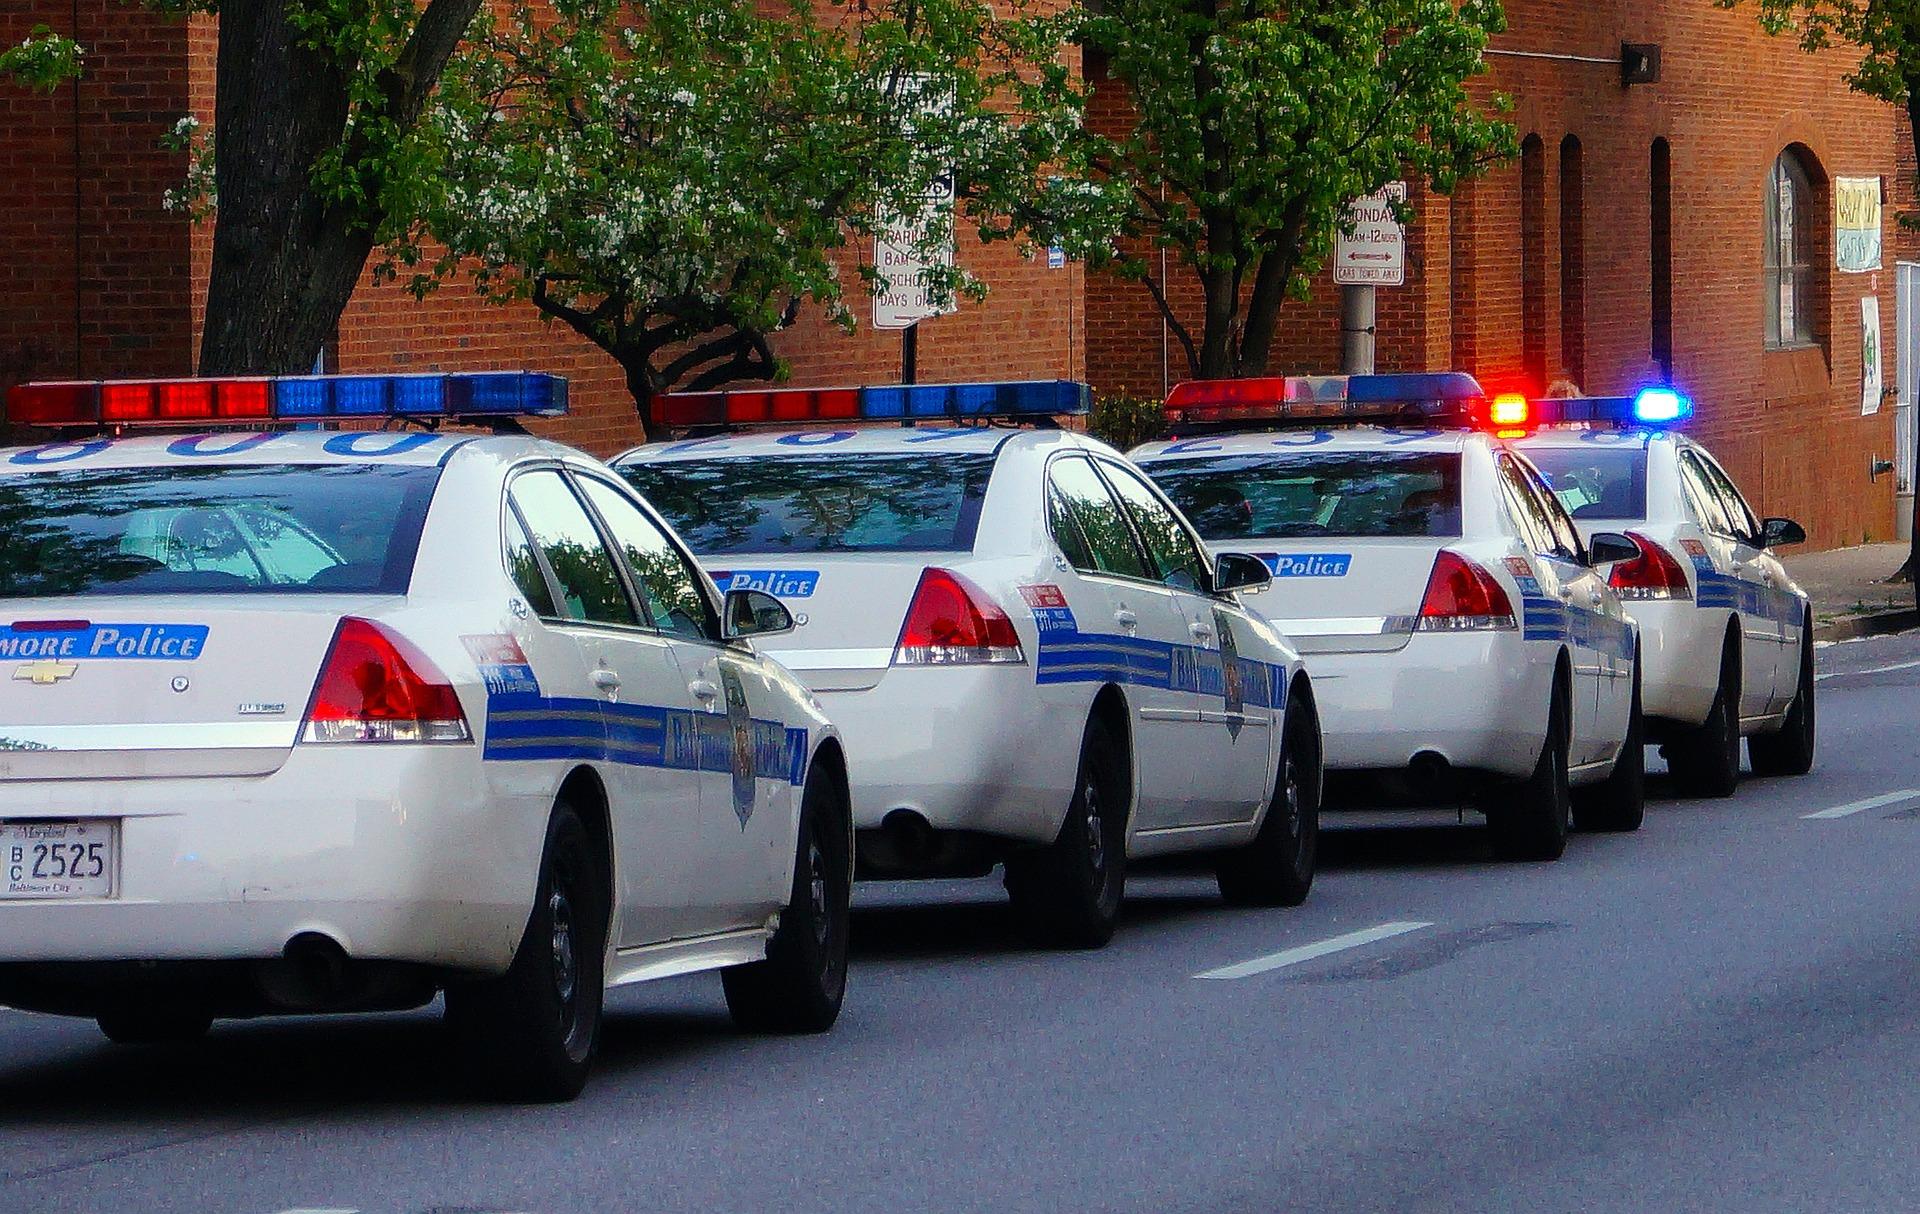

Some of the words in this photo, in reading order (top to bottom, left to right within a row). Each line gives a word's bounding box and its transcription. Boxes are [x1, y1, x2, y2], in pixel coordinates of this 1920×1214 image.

[1347, 208, 1393, 222] ONDAY
[881, 294, 907, 306] DAYS
[32, 843, 104, 878] 2525
